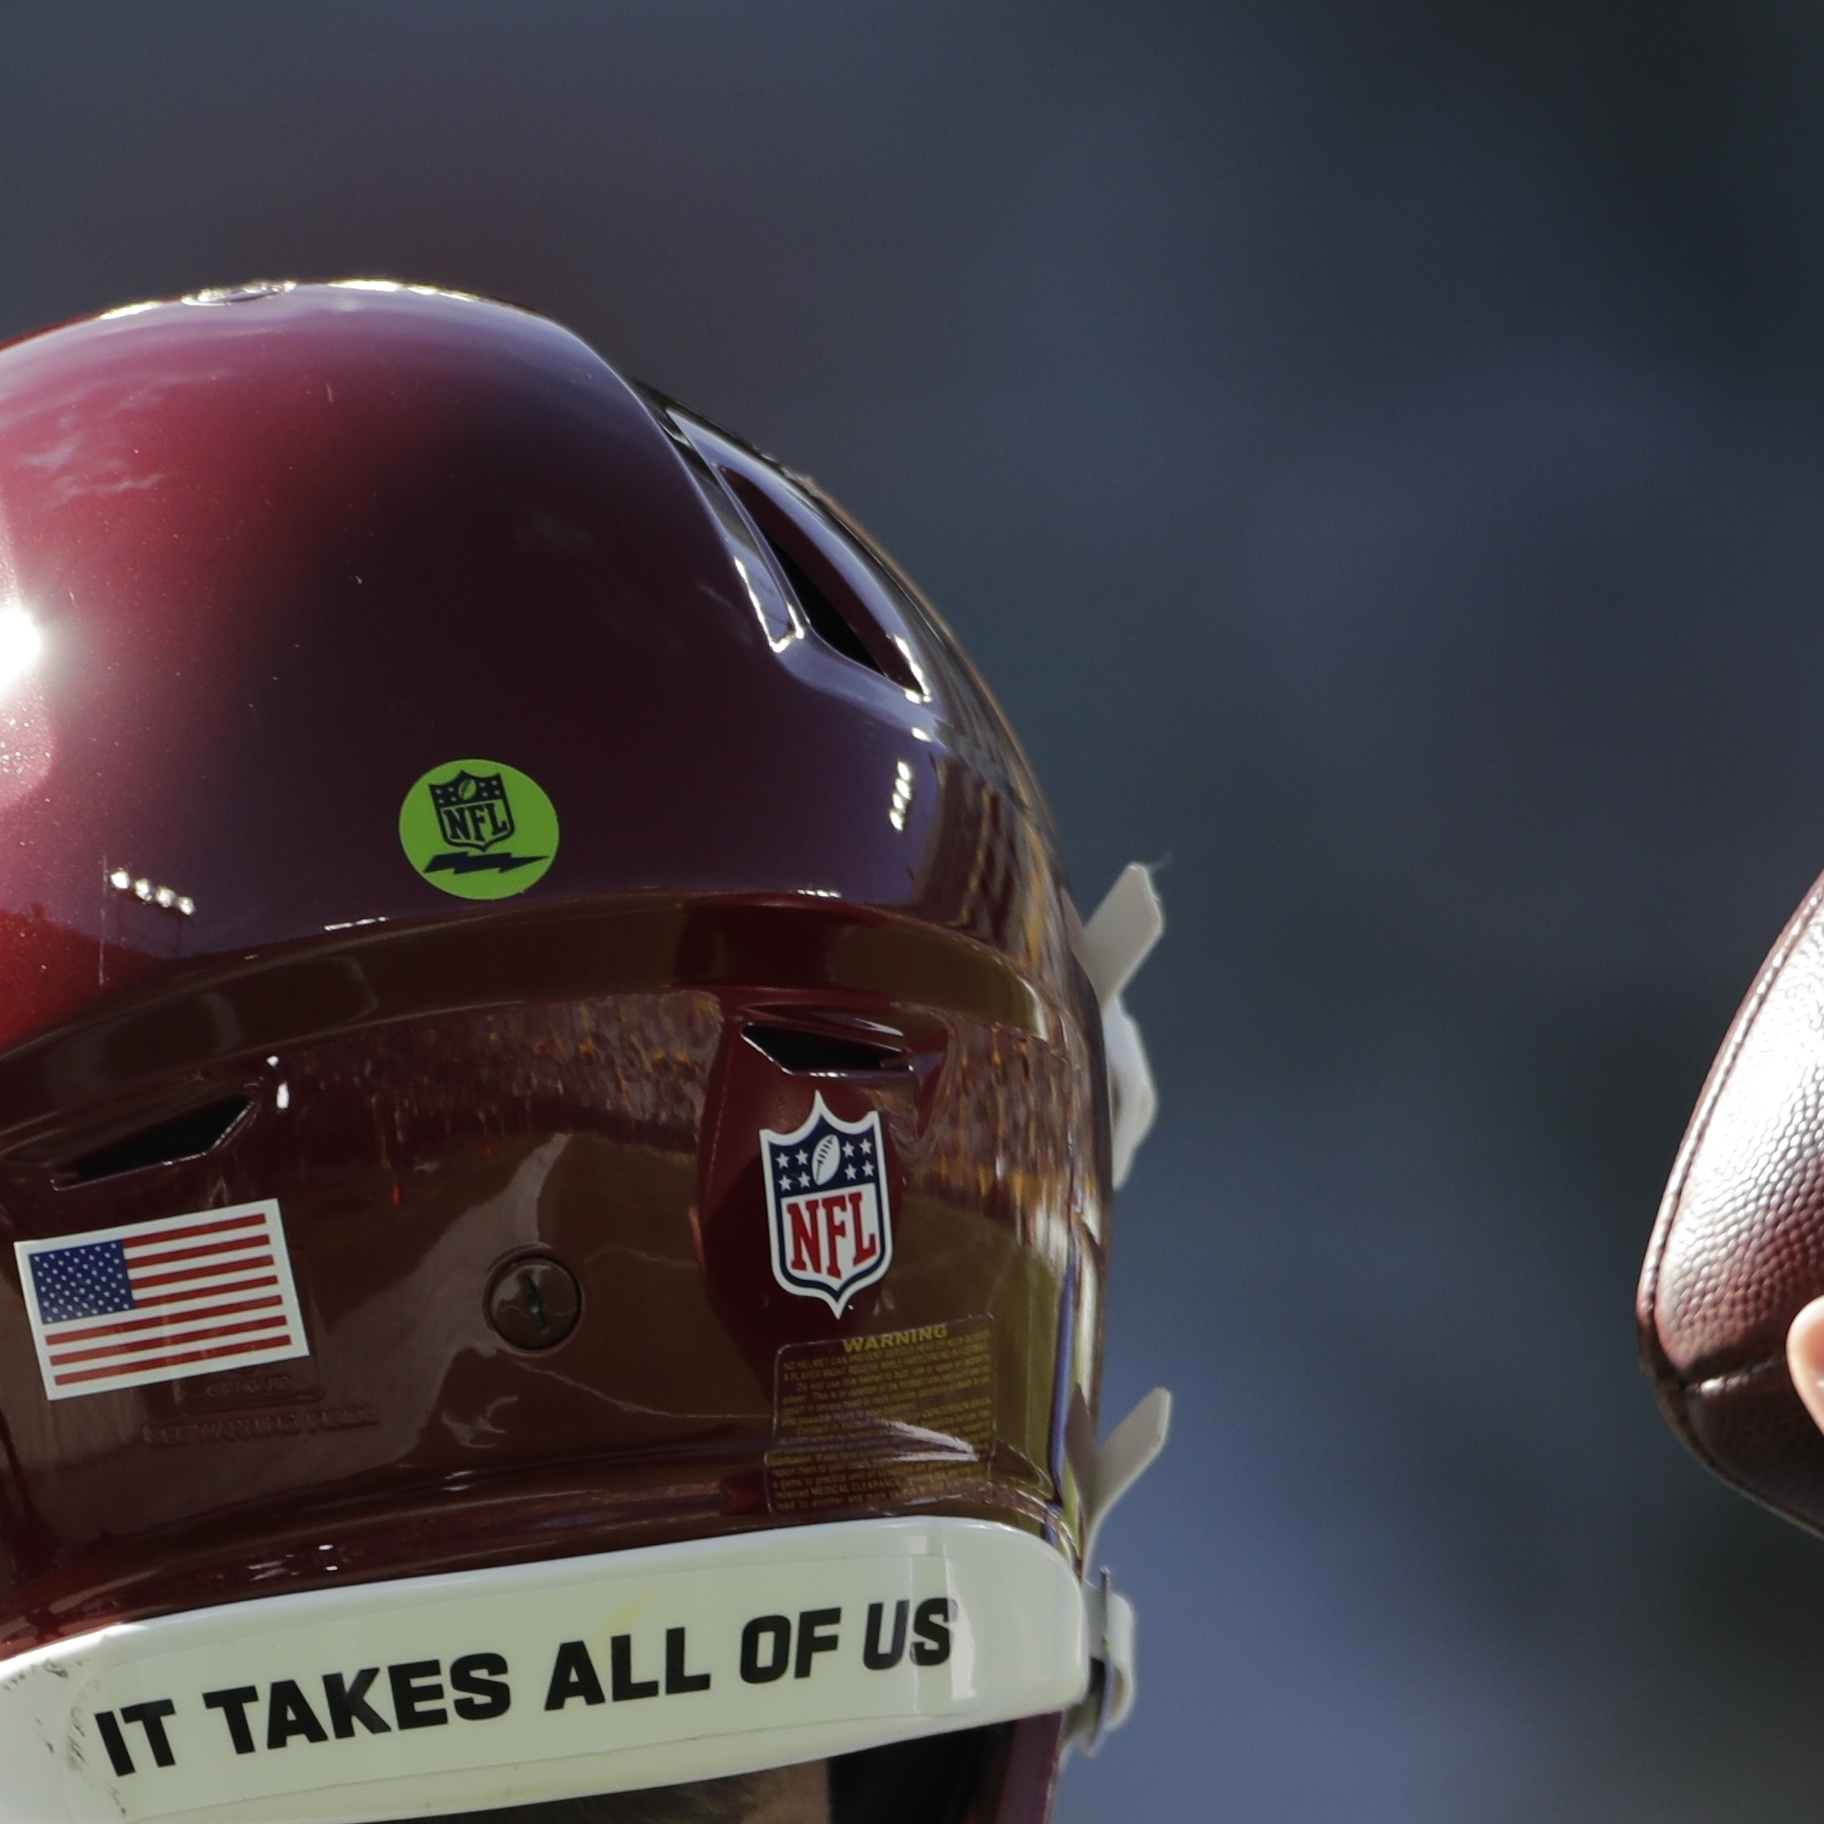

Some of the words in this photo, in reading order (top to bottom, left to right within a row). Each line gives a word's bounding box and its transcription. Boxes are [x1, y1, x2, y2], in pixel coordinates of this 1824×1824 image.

[443, 803, 508, 841] NFL
[786, 1191, 877, 1280] NFL
[843, 1324, 948, 1351] WARNING
[95, 1699, 177, 1777] IT
[204, 1651, 512, 1756] TAKES
[544, 1626, 712, 1713] ALL
[739, 1607, 843, 1685] OF
[862, 1596, 958, 1671] US
